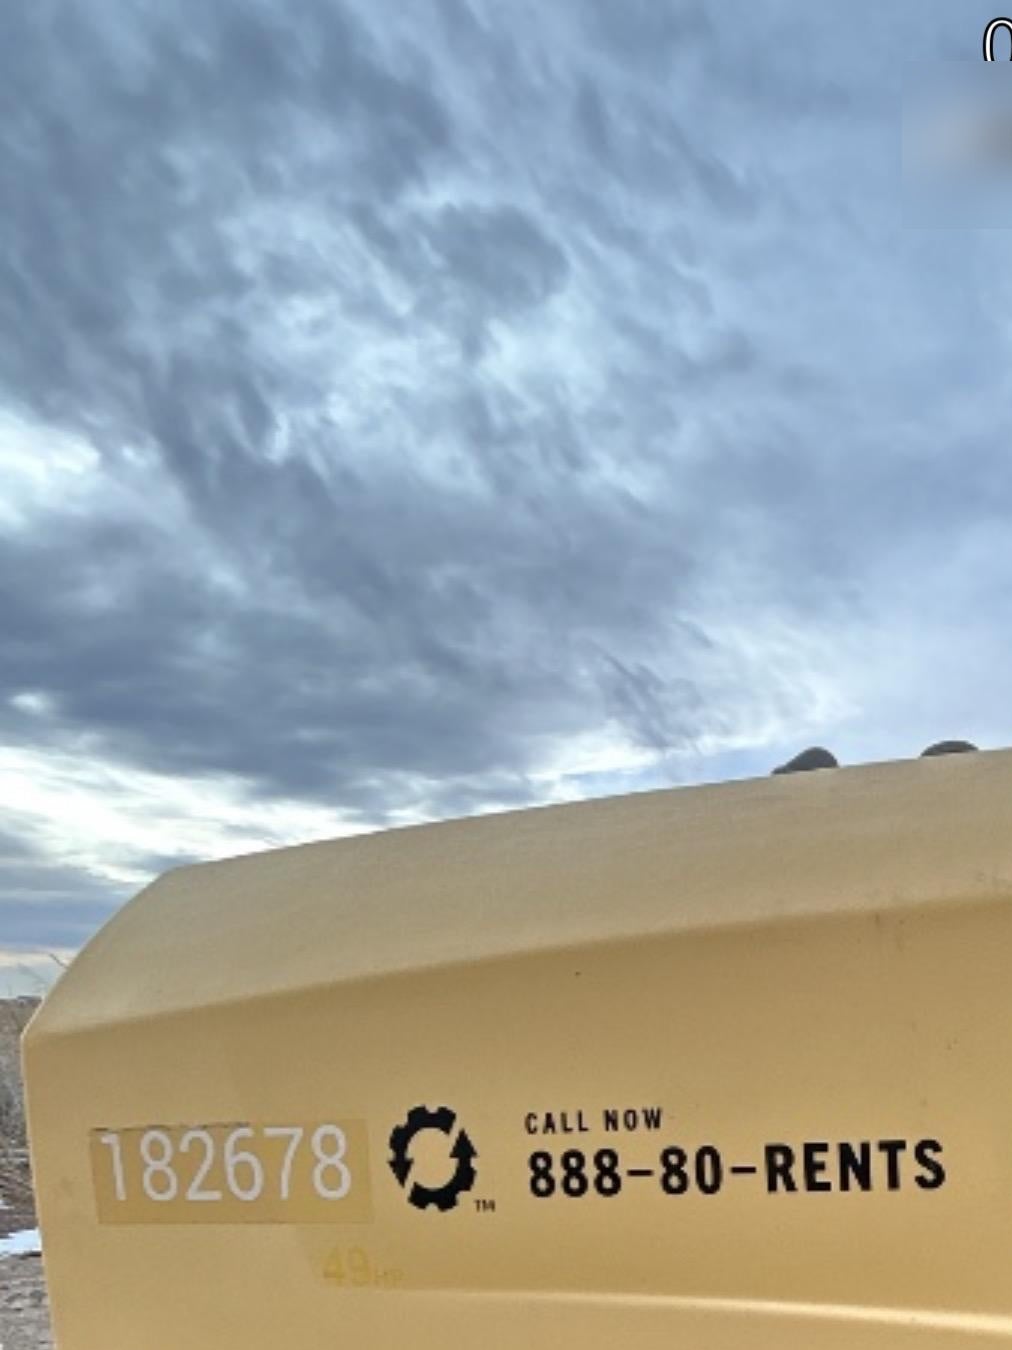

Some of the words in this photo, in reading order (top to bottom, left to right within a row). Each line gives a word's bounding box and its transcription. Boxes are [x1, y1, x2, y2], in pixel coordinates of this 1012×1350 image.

[524, 1110, 589, 1135] CALL
[603, 1107, 662, 1132] NOW
[101, 1124, 352, 1201] 182678
[528, 1139, 946, 1198] 888-80-RENTS
